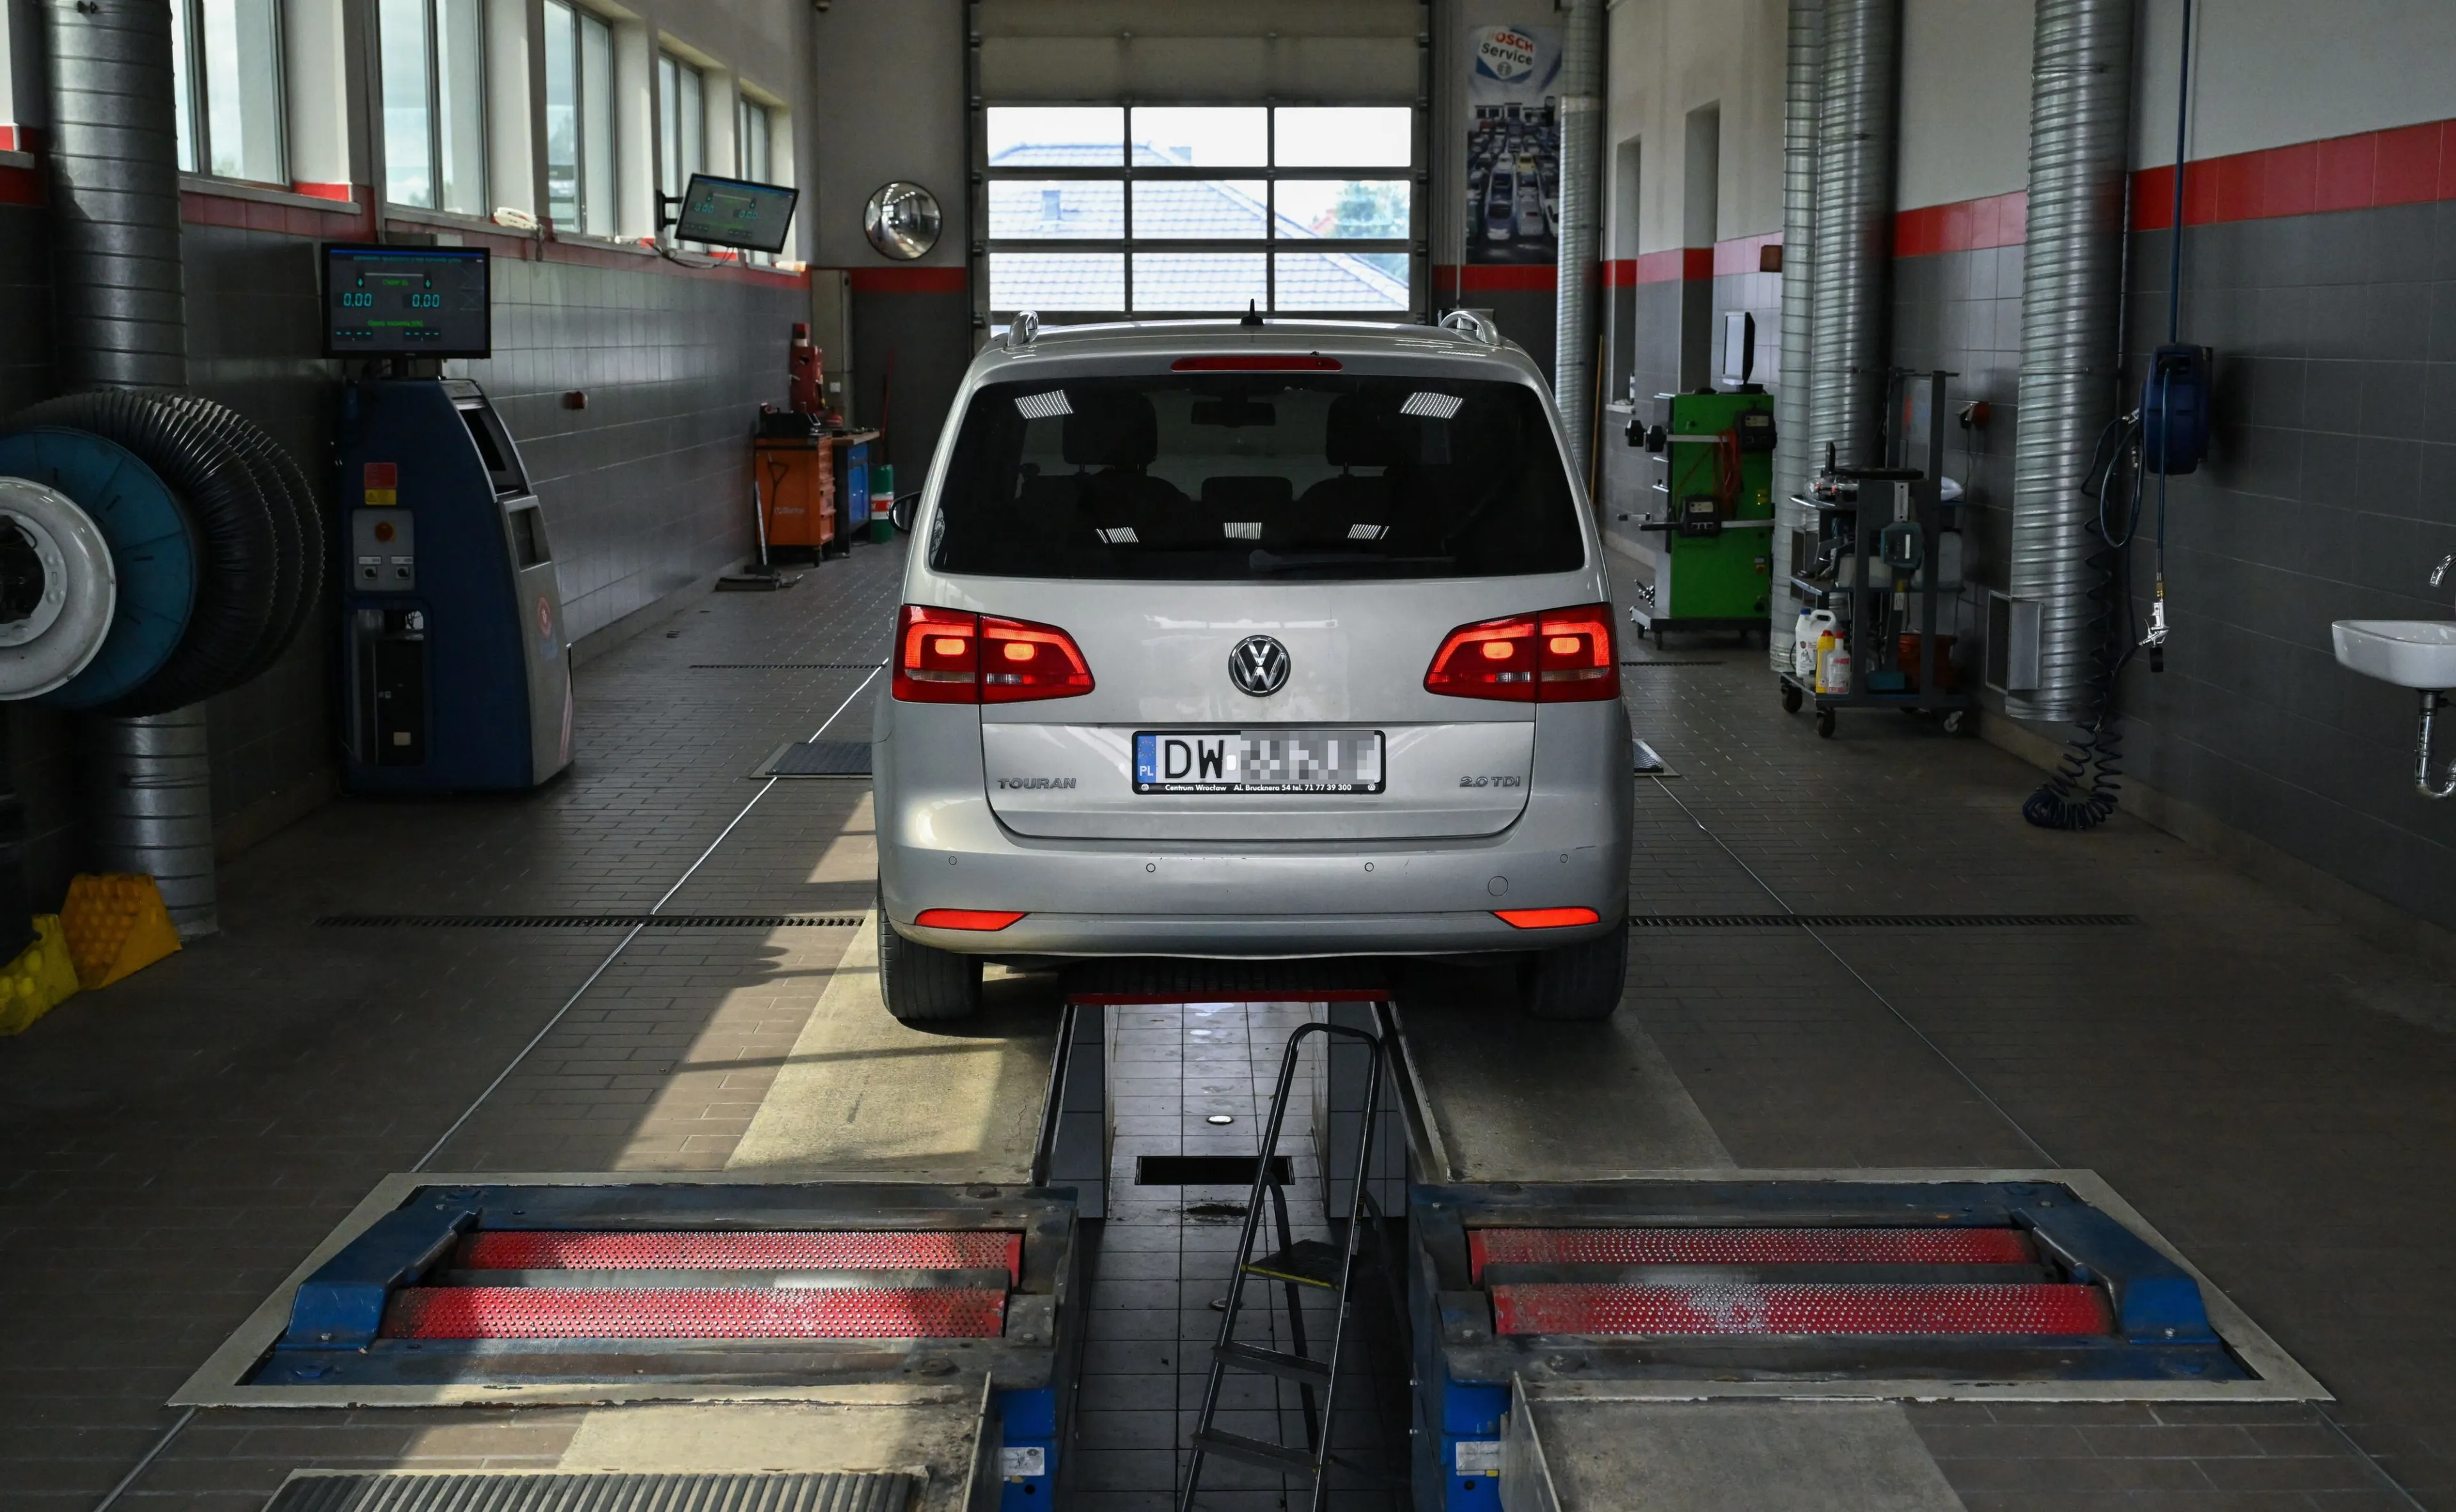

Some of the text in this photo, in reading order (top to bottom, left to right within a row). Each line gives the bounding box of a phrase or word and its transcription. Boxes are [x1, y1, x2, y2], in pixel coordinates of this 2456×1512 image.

[1481, 42, 1533, 65] Service
[343, 292, 373, 308] 0.00
[412, 294, 441, 308] 0.00
[1139, 766, 1154, 776] PL
[997, 778, 1076, 789] TOURAN
[1460, 776, 1521, 787] 2.0 TDI
